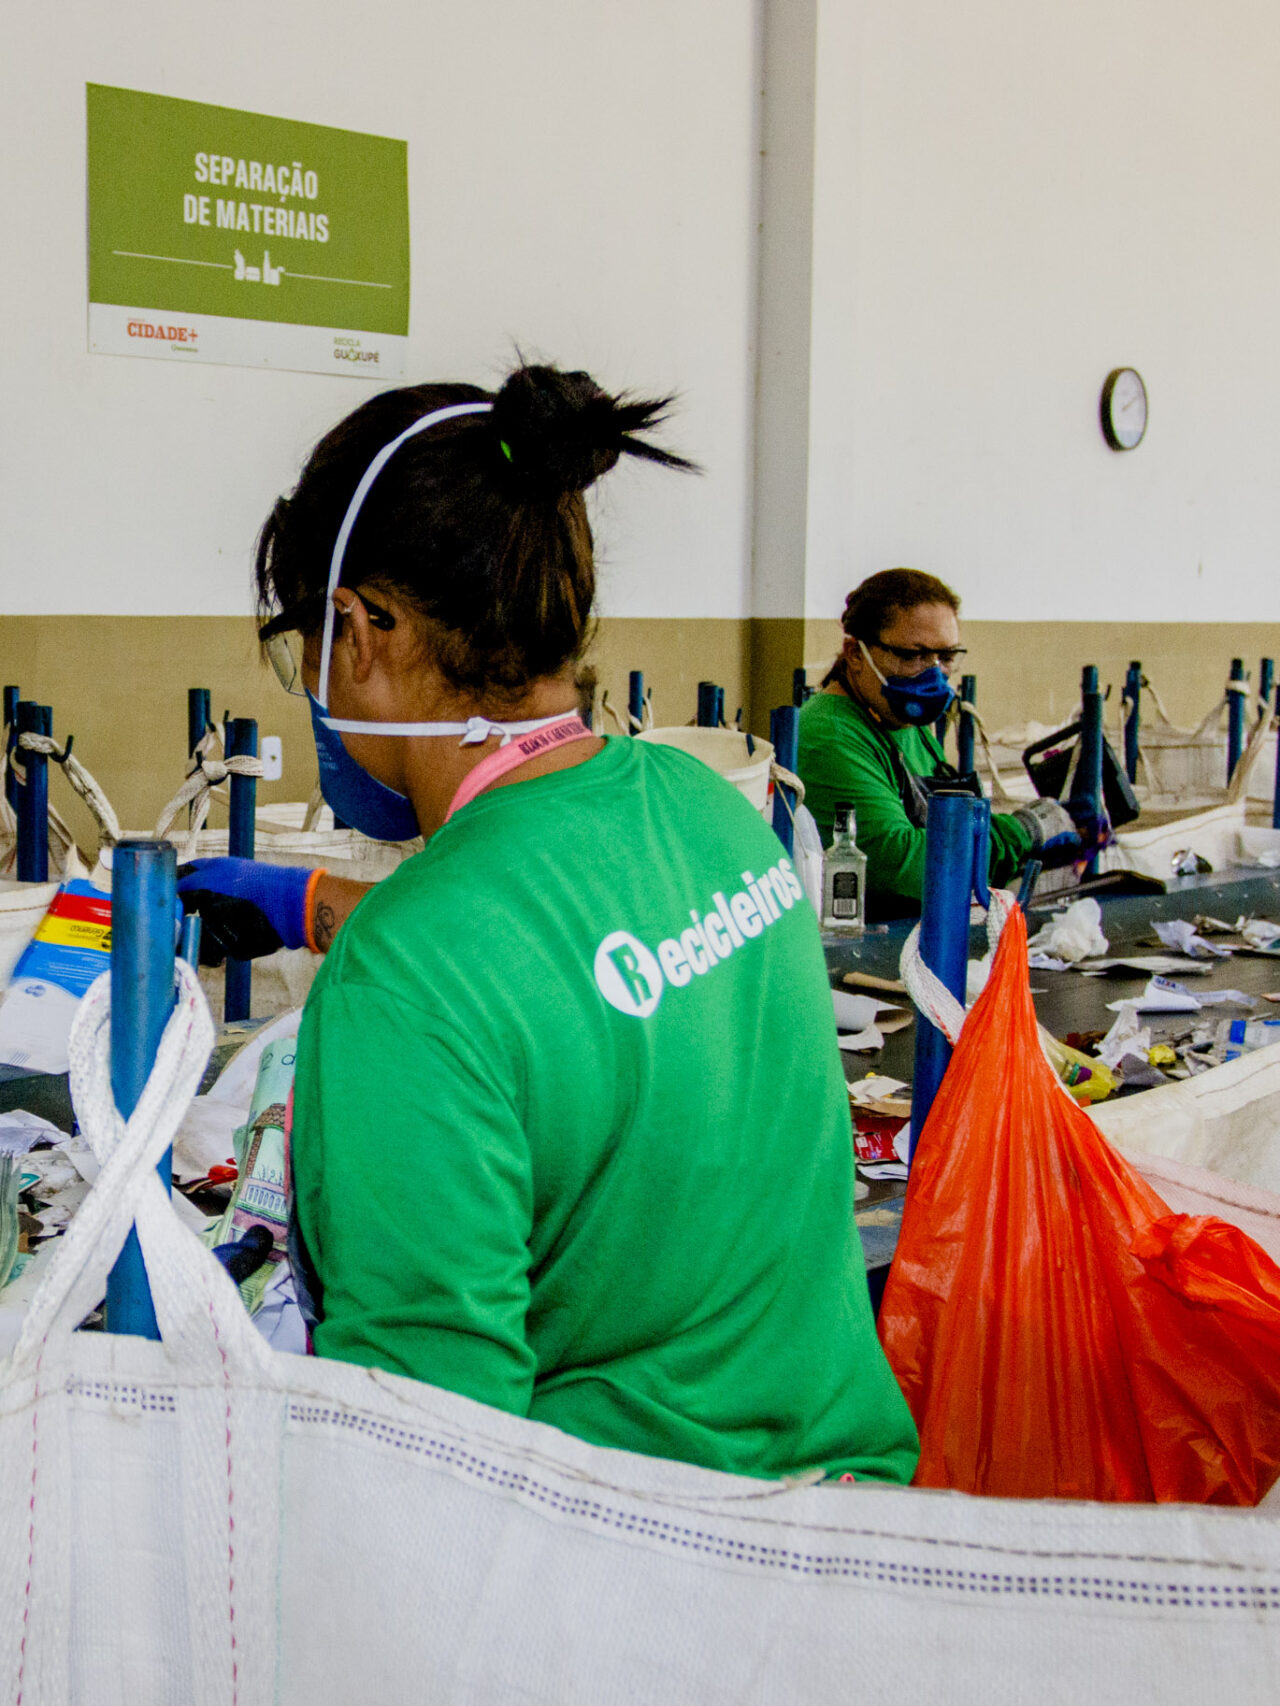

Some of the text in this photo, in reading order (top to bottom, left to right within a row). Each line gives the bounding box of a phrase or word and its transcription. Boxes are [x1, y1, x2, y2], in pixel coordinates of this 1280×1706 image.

[194, 151, 319, 203] SEPARAÇÃO
[183, 193, 330, 243] DE MATERIAIS
[594, 858, 804, 1018] Recicleiros
